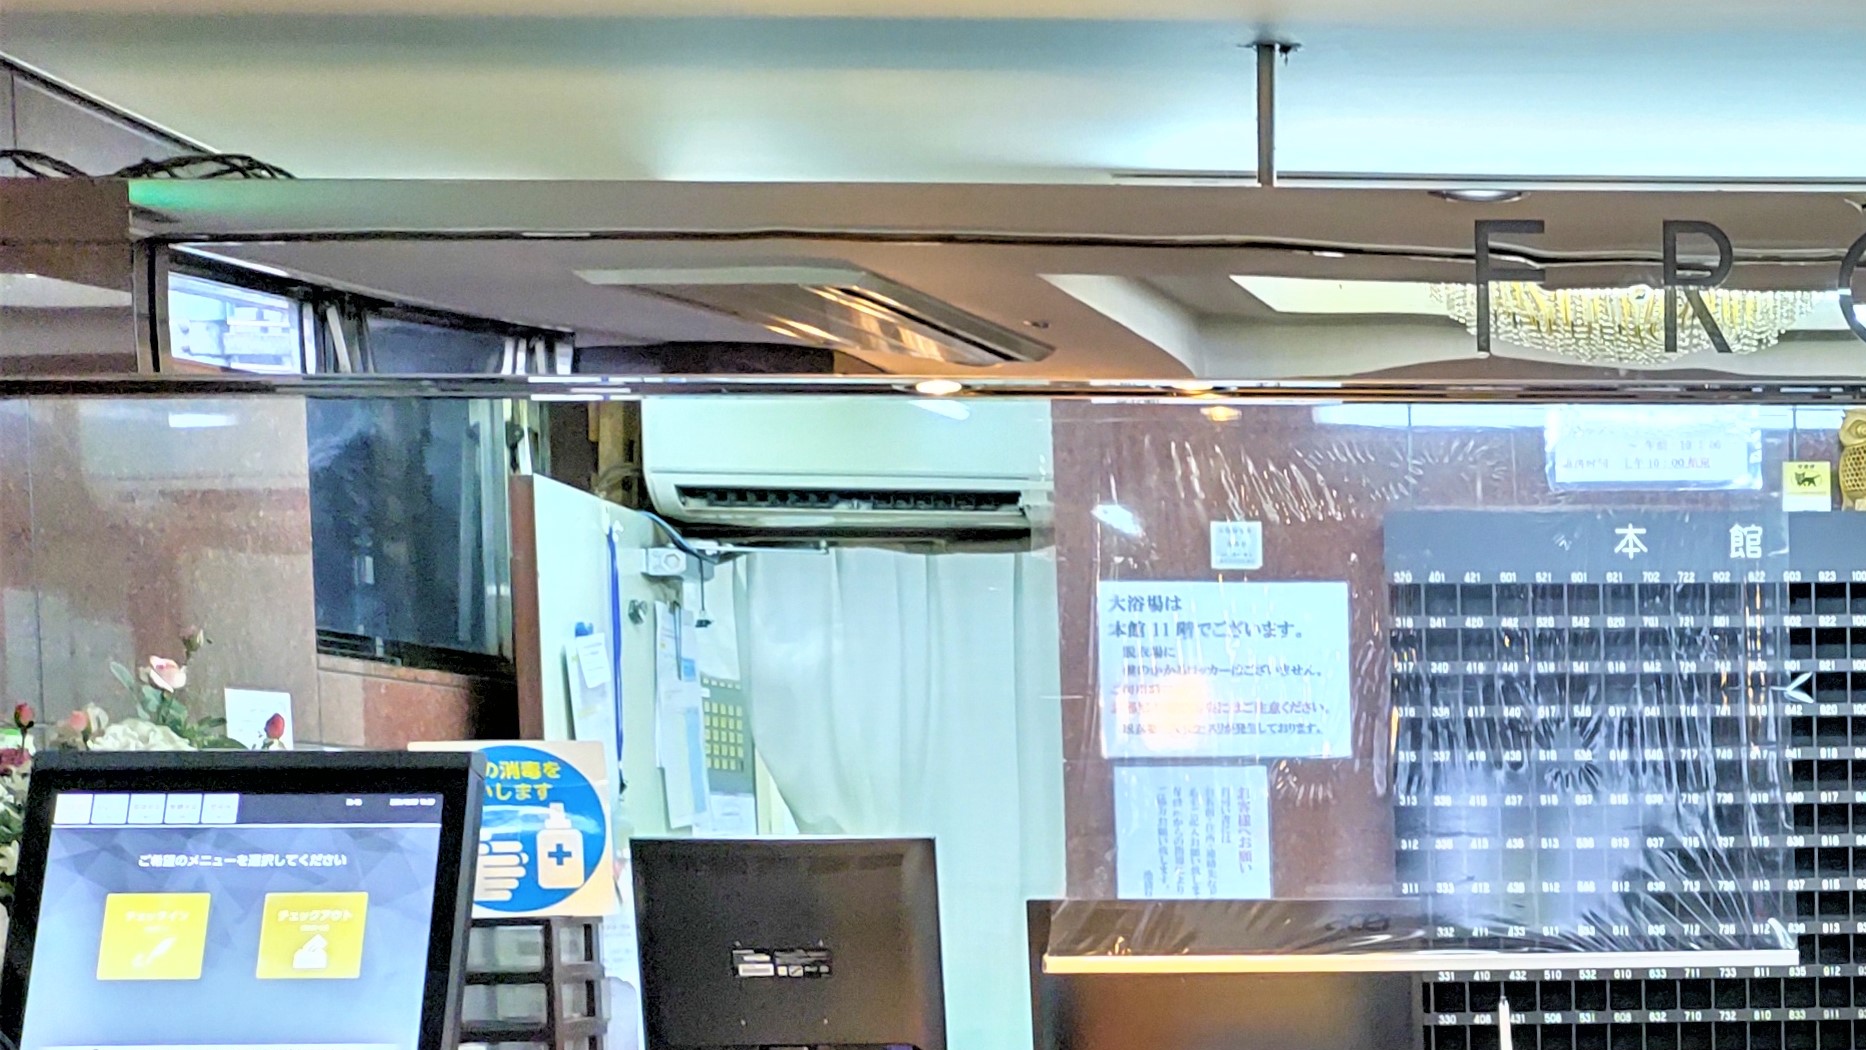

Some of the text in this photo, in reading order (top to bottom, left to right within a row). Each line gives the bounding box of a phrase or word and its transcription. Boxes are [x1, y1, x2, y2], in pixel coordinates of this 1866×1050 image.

[1109, 595, 1182, 612] 大浴場は
[138, 854, 347, 869] ご希望のメニューを選択してください
